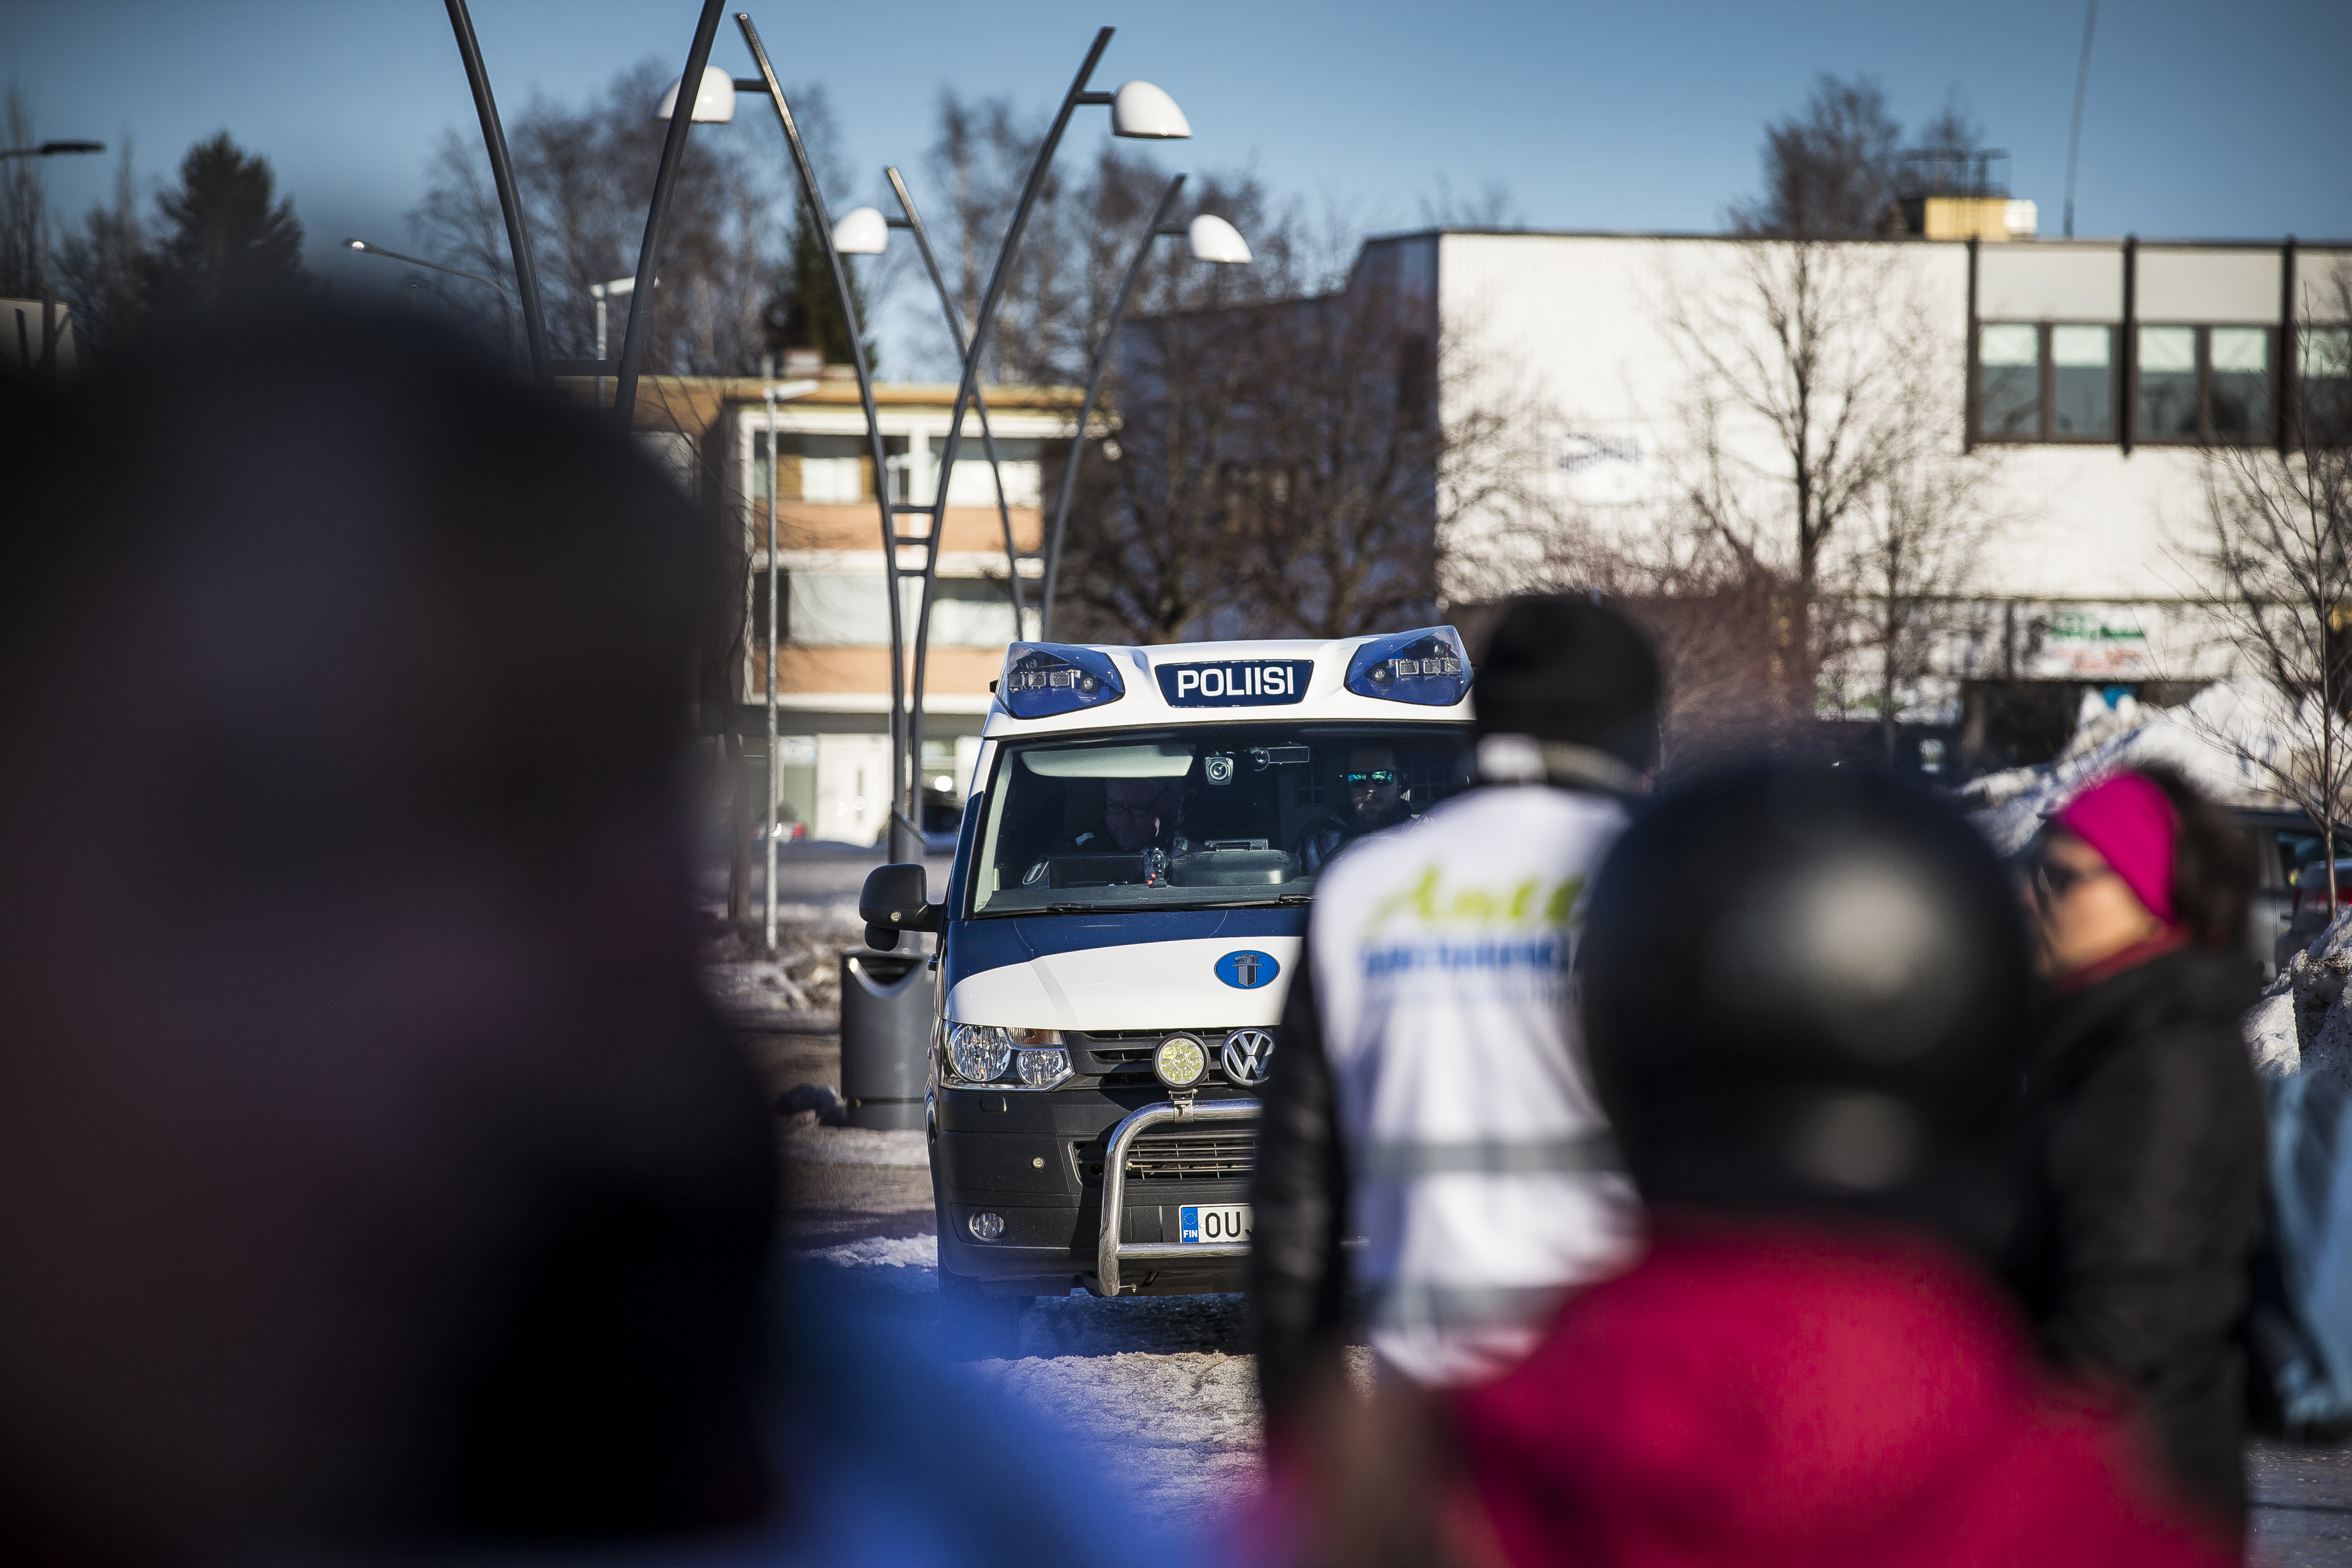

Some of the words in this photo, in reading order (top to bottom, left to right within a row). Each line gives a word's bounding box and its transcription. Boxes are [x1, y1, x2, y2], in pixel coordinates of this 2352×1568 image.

[1178, 667, 1294, 698] POLIISI
[1223, 1029, 1275, 1084] VW
[1183, 1229, 1198, 1238] FIN
[1205, 1210, 1252, 1238] OU
